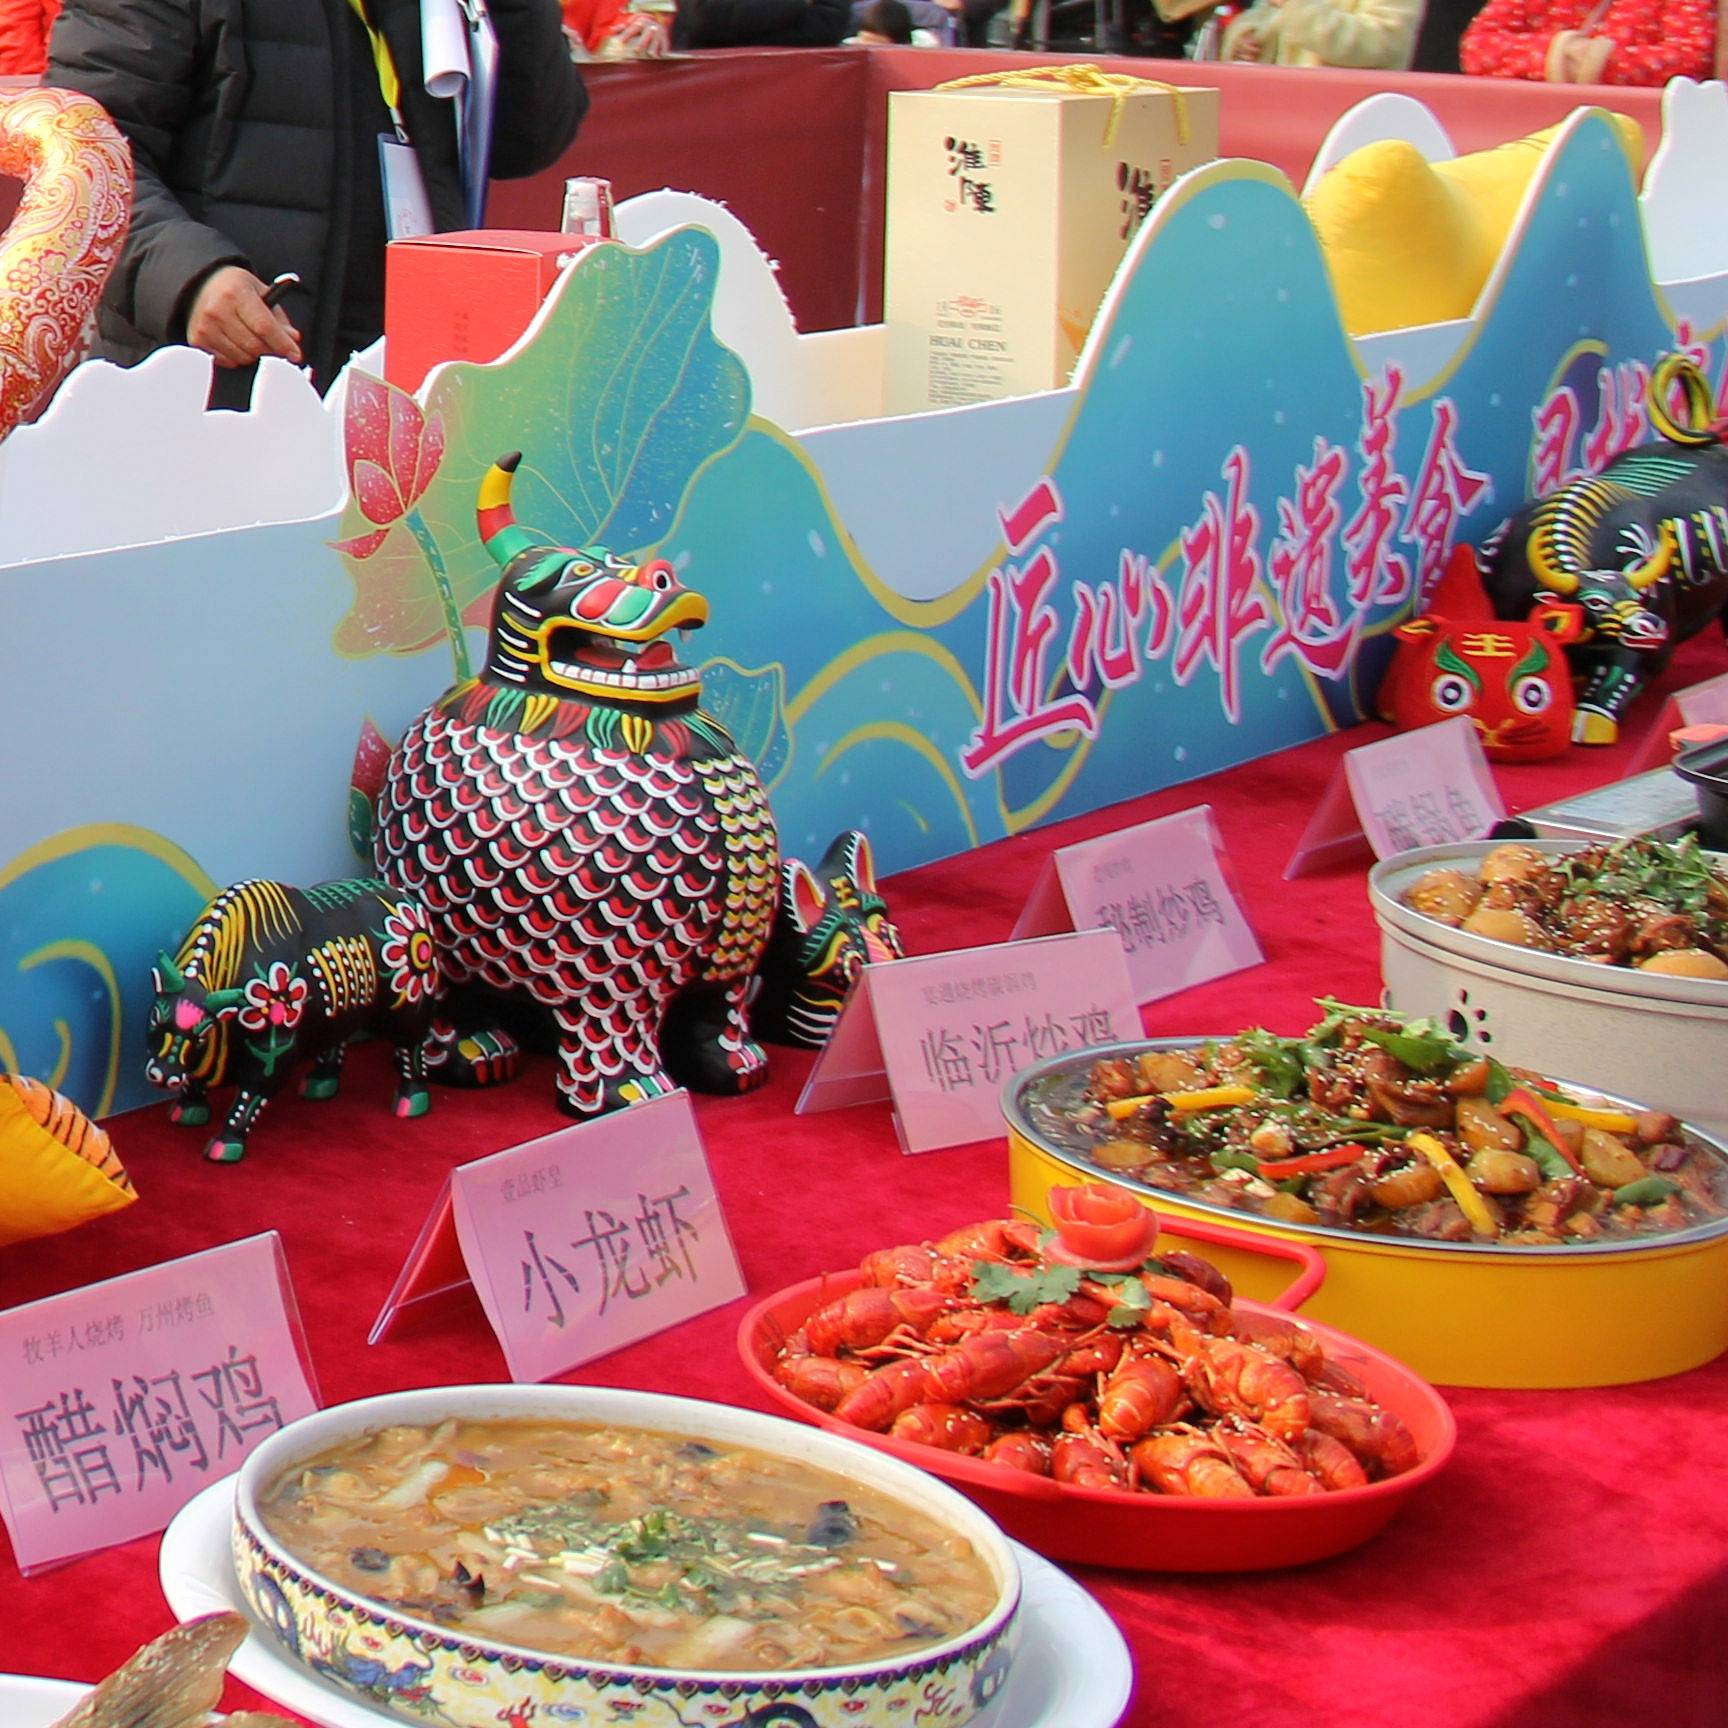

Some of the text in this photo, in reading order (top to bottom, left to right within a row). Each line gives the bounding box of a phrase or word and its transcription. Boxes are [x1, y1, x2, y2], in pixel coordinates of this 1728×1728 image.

[519, 1183, 700, 1330] 小龙虾
[14, 1344, 287, 1516] 醋焖鸡
